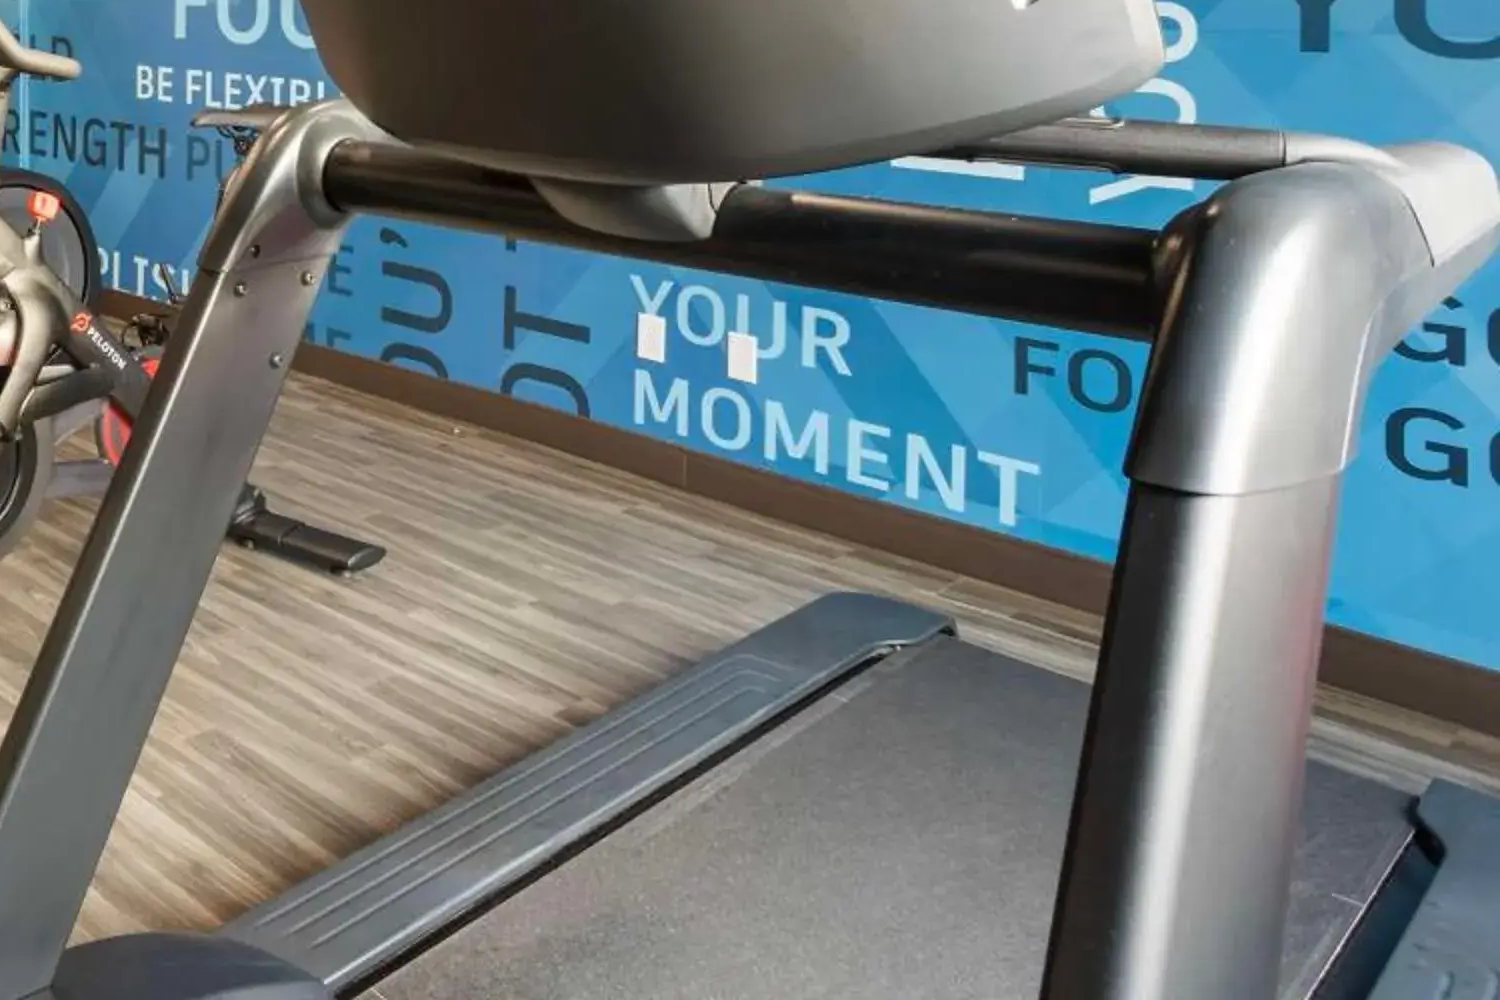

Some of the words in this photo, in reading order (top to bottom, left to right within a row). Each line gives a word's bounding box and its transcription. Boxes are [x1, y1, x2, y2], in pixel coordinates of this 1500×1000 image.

[136, 64, 174, 102] BE
[186, 69, 345, 111] FLEXIB
[87, 327, 127, 371] PELOTON
[629, 274, 853, 377] YOUR
[633, 368, 1041, 527] MOMENT
